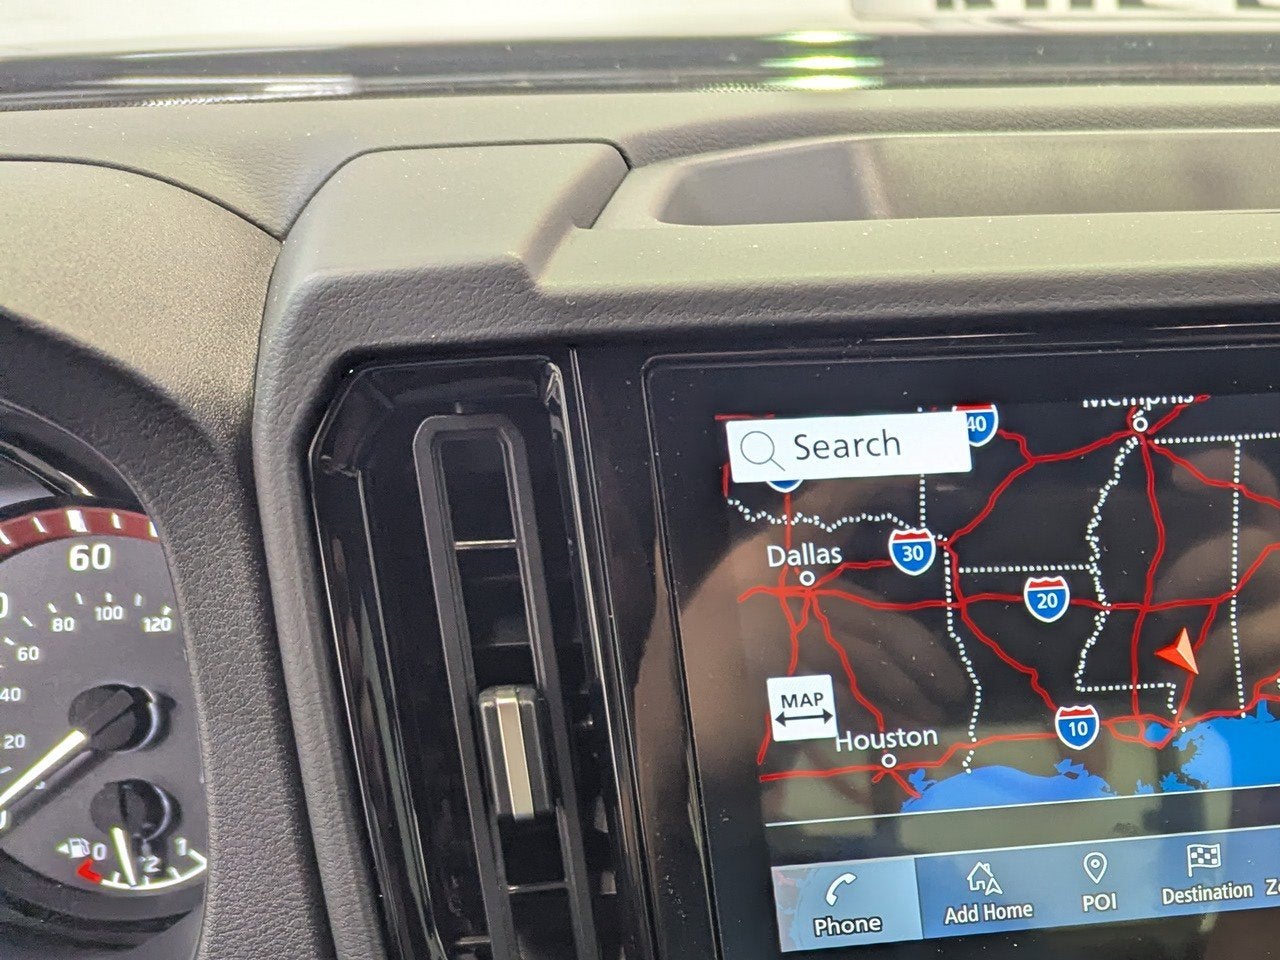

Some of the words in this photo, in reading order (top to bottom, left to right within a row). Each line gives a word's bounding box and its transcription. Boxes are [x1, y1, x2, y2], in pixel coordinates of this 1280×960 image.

[967, 415, 987, 432] 40
[794, 429, 901, 461] Search
[69, 543, 112, 571] 60
[767, 543, 843, 567] Dallas
[902, 546, 924, 562] 30
[1037, 593, 1058, 610] 20
[94, 604, 123, 622] 100
[52, 615, 75, 633] 80
[144, 616, 172, 633] 120
[17, 645, 40, 662] 60
[0, 687, 21, 702] 40
[781, 691, 824, 708] MAP
[1068, 720, 1088, 737] 10
[4, 733, 26, 749] 20
[835, 726, 939, 752] Houston
[1162, 881, 1253, 905] Destination
[1082, 893, 1117, 912] POI
[944, 905, 980, 924] Add
[983, 901, 1034, 921] Home
[814, 914, 882, 937] Phone
